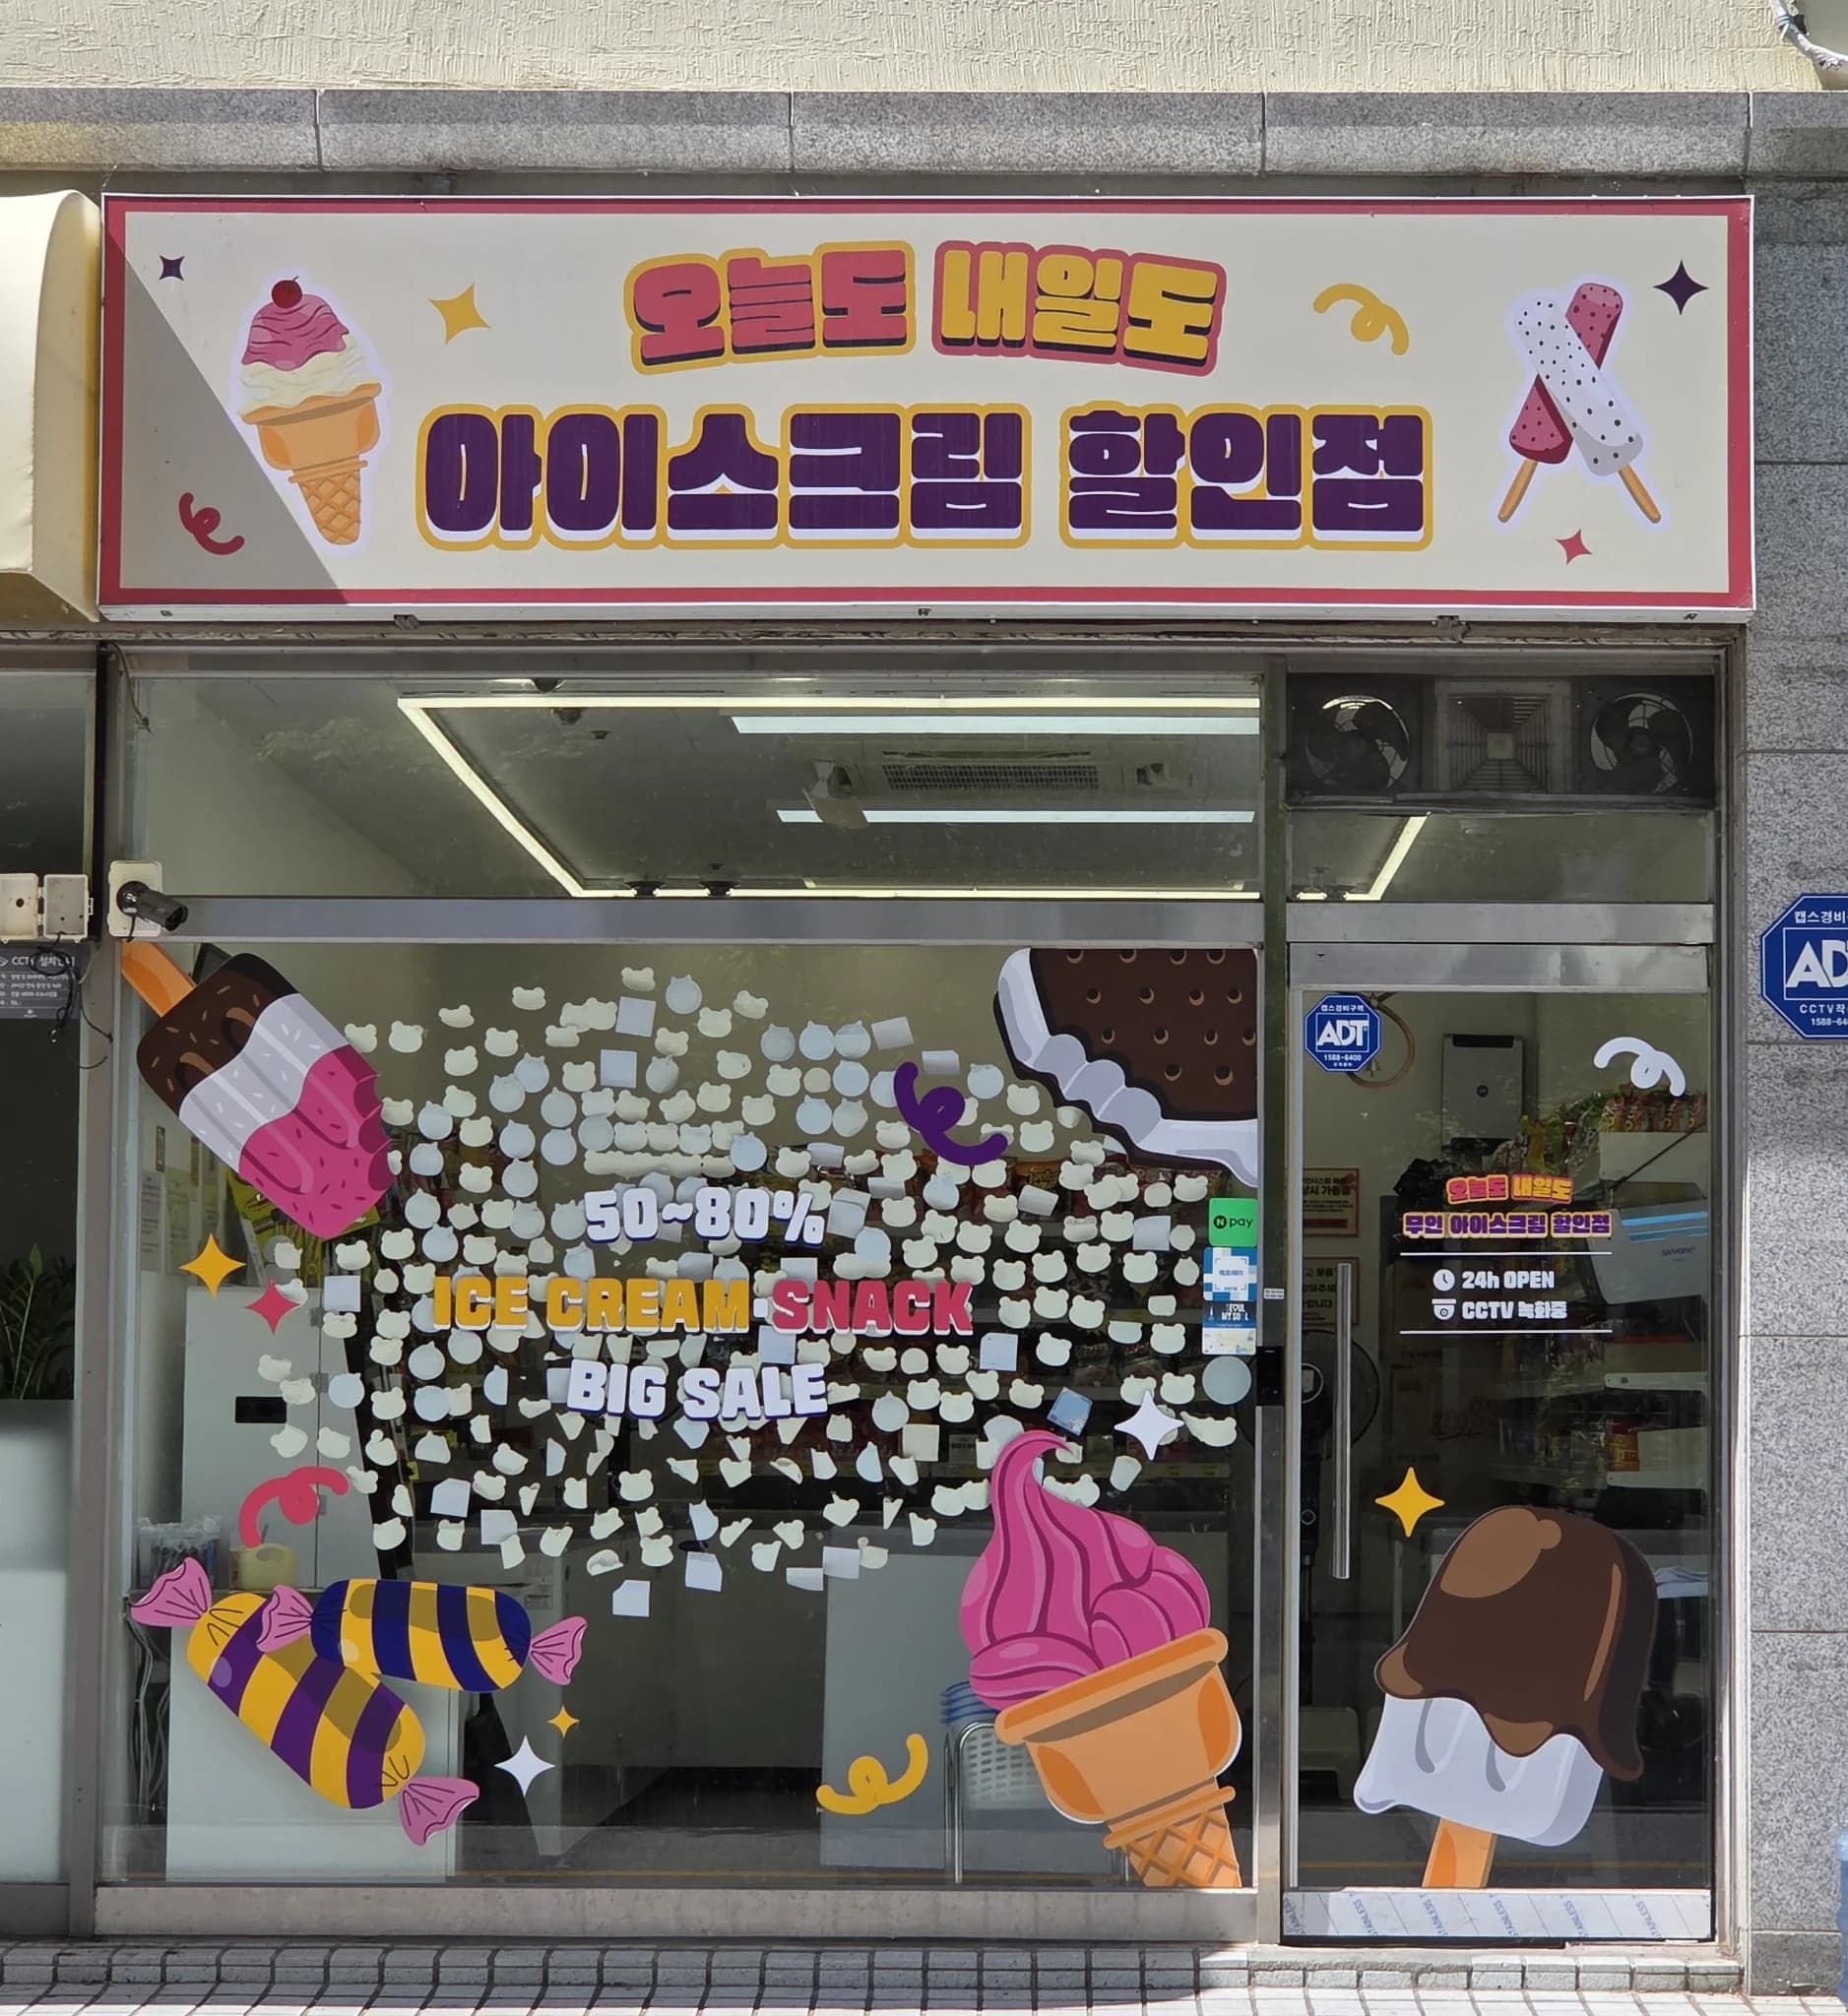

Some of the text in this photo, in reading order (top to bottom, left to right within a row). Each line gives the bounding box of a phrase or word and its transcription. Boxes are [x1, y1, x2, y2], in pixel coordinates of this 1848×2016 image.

[631, 246, 1220, 369] 오늘도 내일도
[423, 410, 1426, 541] 아이스크림 할인점
[1794, 911, 1848, 923] 캡스경비
[1786, 939, 1848, 988] AD
[1799, 1004, 1848, 1015] CCTV작
[1316, 1019, 1370, 1046] ADT
[1446, 1175, 1573, 1204] 오늘도 내일도
[584, 1186, 826, 1246] 50~80%
[1405, 1213, 1611, 1236] 무인 아이스크림 할인점
[1461, 1270, 1556, 1290] 24h OPEN
[432, 1276, 528, 1332] ICE
[545, 1277, 750, 1334] CREAM
[772, 1280, 974, 1336] SNACK
[1461, 1300, 1568, 1320] CCTV 녹화중
[566, 1358, 829, 1423] BIG SALE
